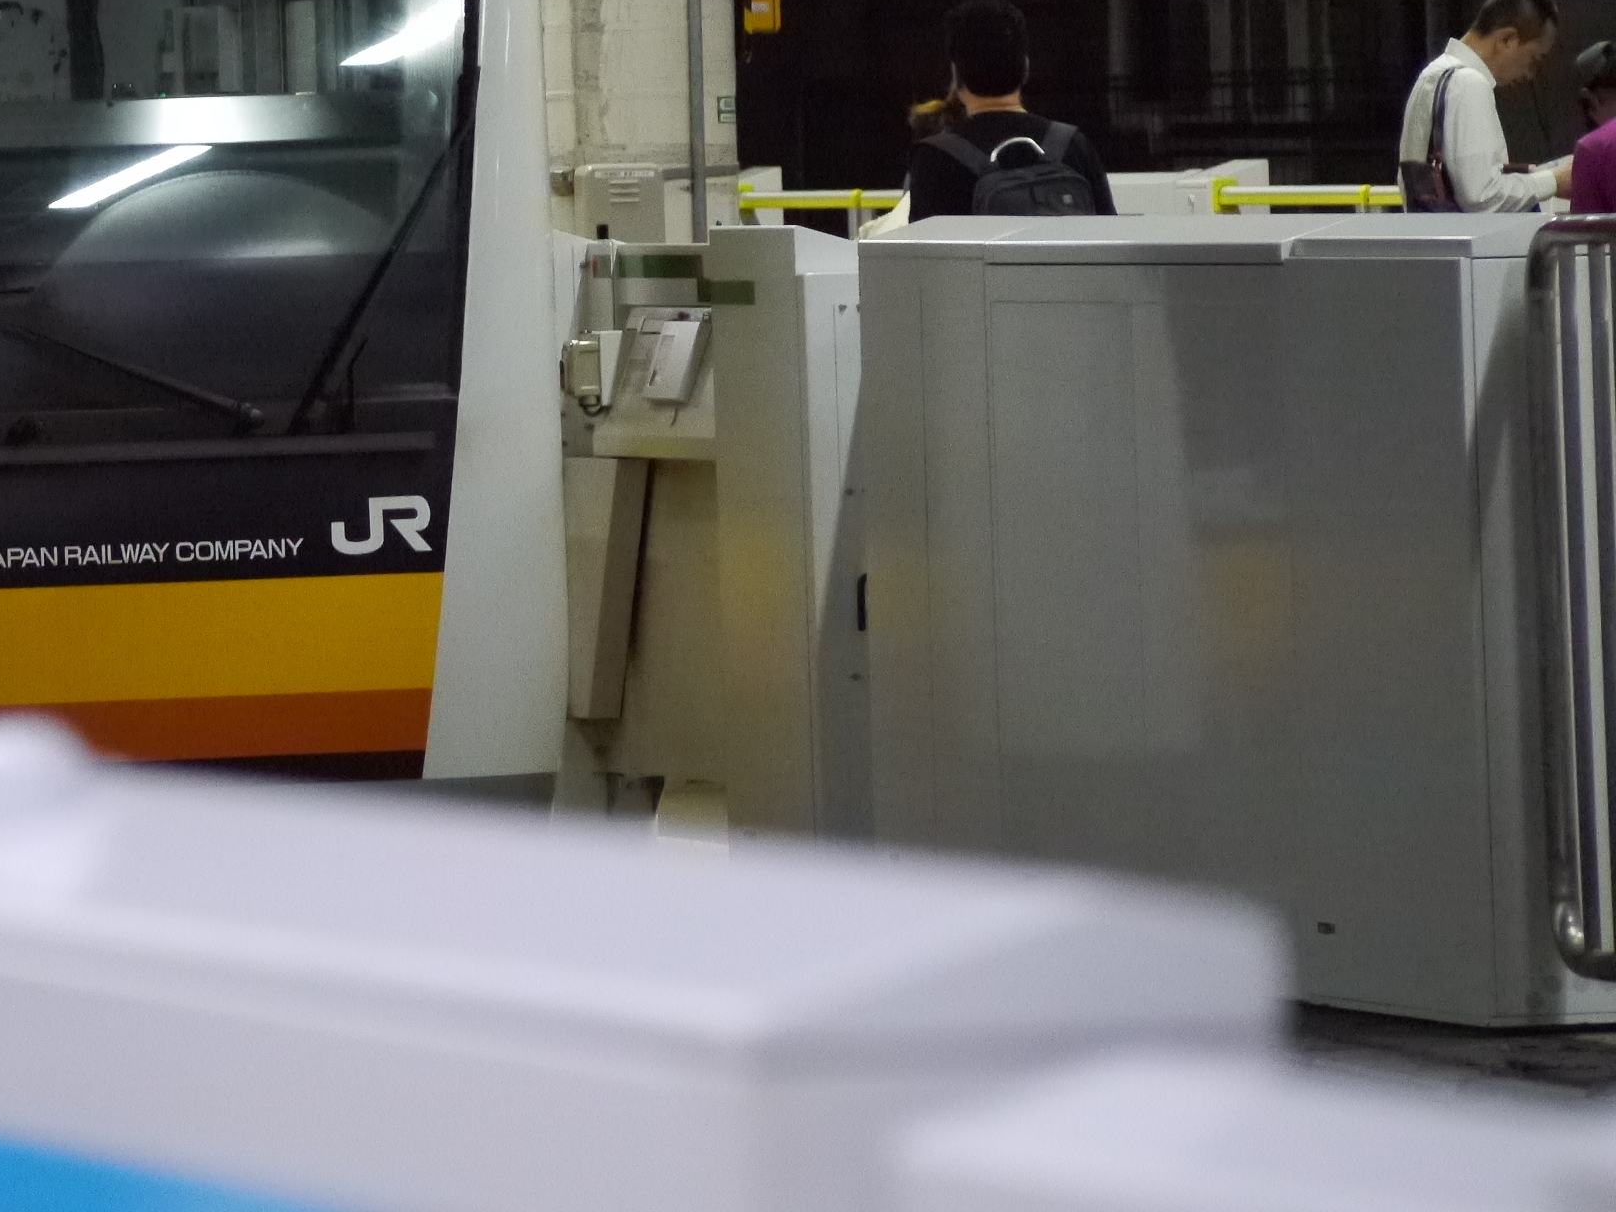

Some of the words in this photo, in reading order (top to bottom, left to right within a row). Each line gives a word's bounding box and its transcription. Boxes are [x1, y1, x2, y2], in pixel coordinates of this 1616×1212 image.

[330, 494, 434, 557] JR
[64, 542, 171, 567] RAILWAY
[175, 537, 304, 563] COMPANY
